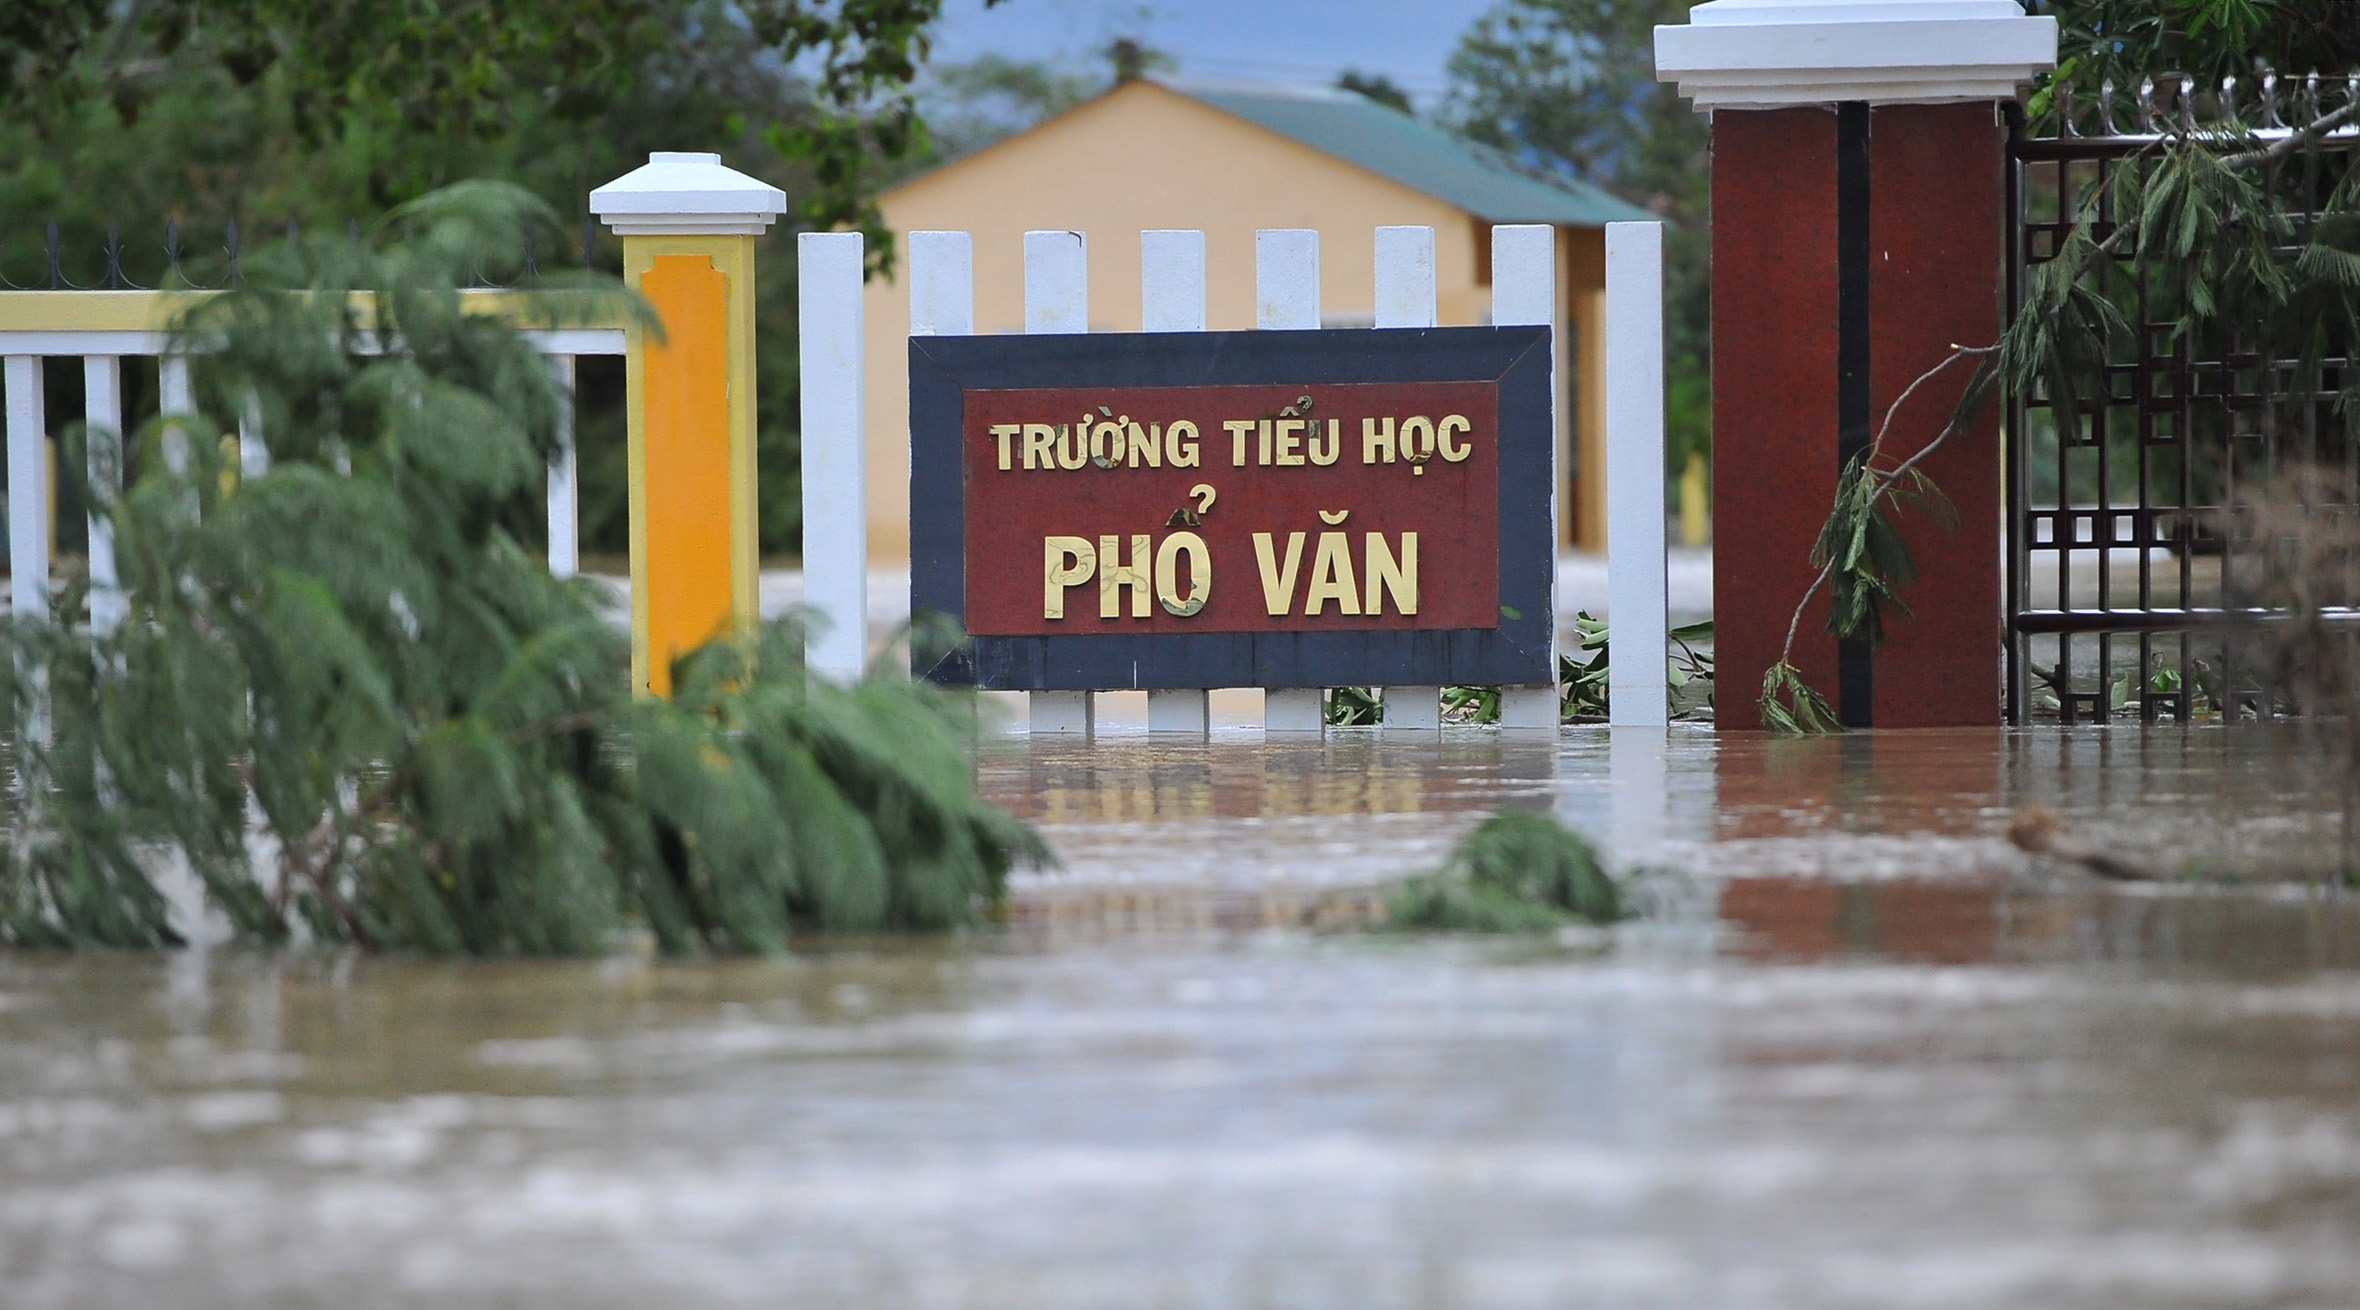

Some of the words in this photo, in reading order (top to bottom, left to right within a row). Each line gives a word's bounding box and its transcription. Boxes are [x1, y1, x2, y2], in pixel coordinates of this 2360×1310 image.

[989, 406, 1200, 471] TRƯỜNG
[1222, 395, 1340, 467] TIỂU
[1362, 414, 1472, 476] HỌC
[1043, 483, 1217, 619] PHỔ
[1251, 509, 1418, 616] VĂN
